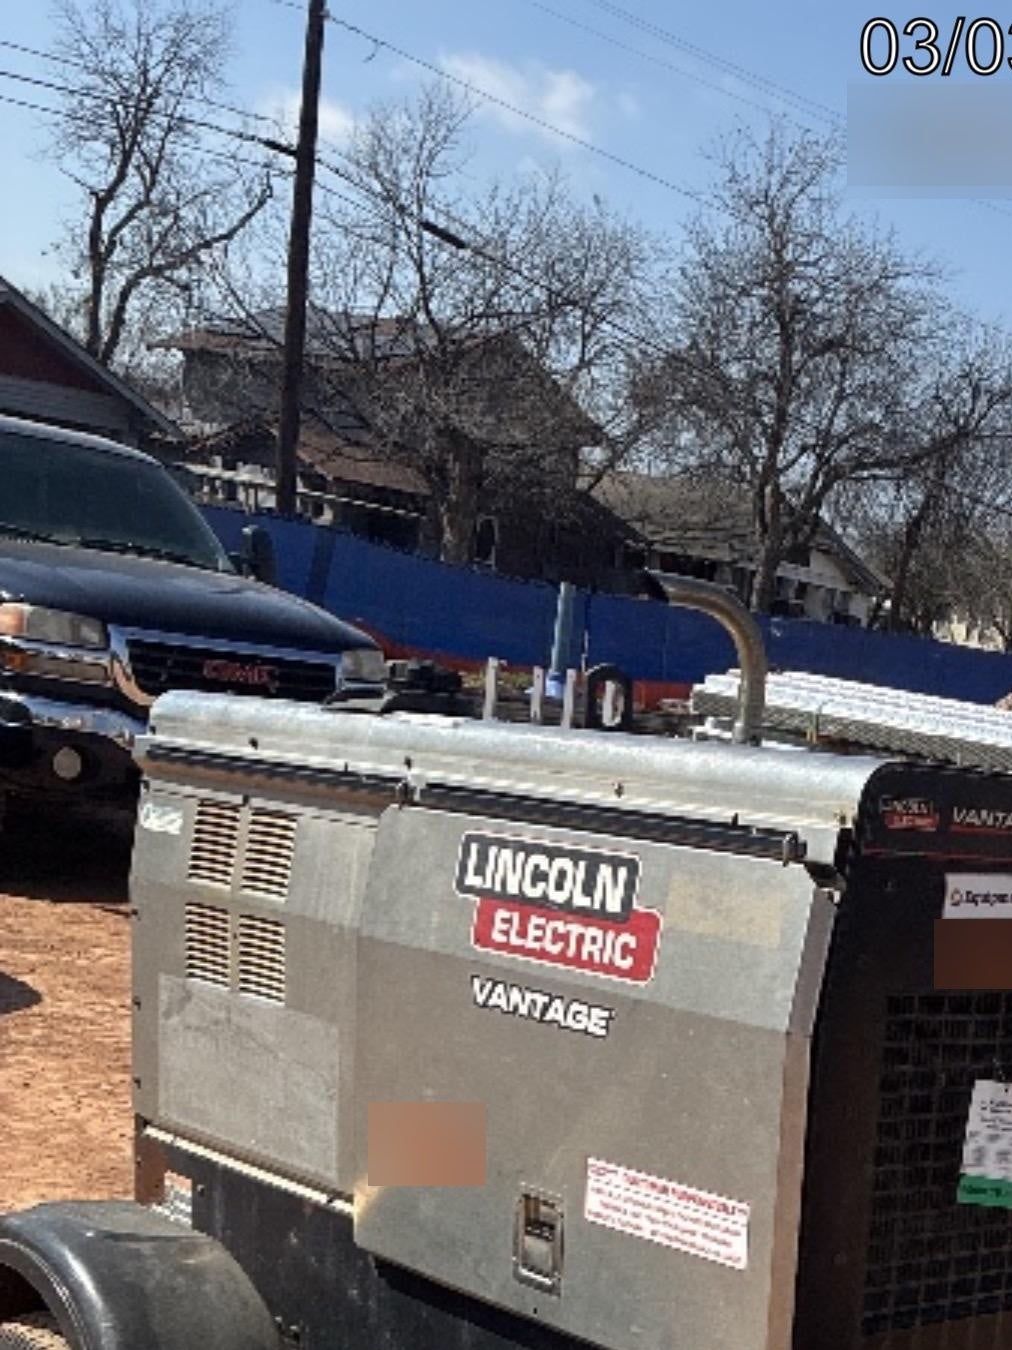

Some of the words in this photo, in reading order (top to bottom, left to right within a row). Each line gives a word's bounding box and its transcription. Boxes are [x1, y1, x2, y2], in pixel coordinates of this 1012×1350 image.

[463, 842, 629, 914] LINCOLN
[490, 907, 638, 970] ELECTRIC
[470, 975, 613, 1038] VANTAGE
